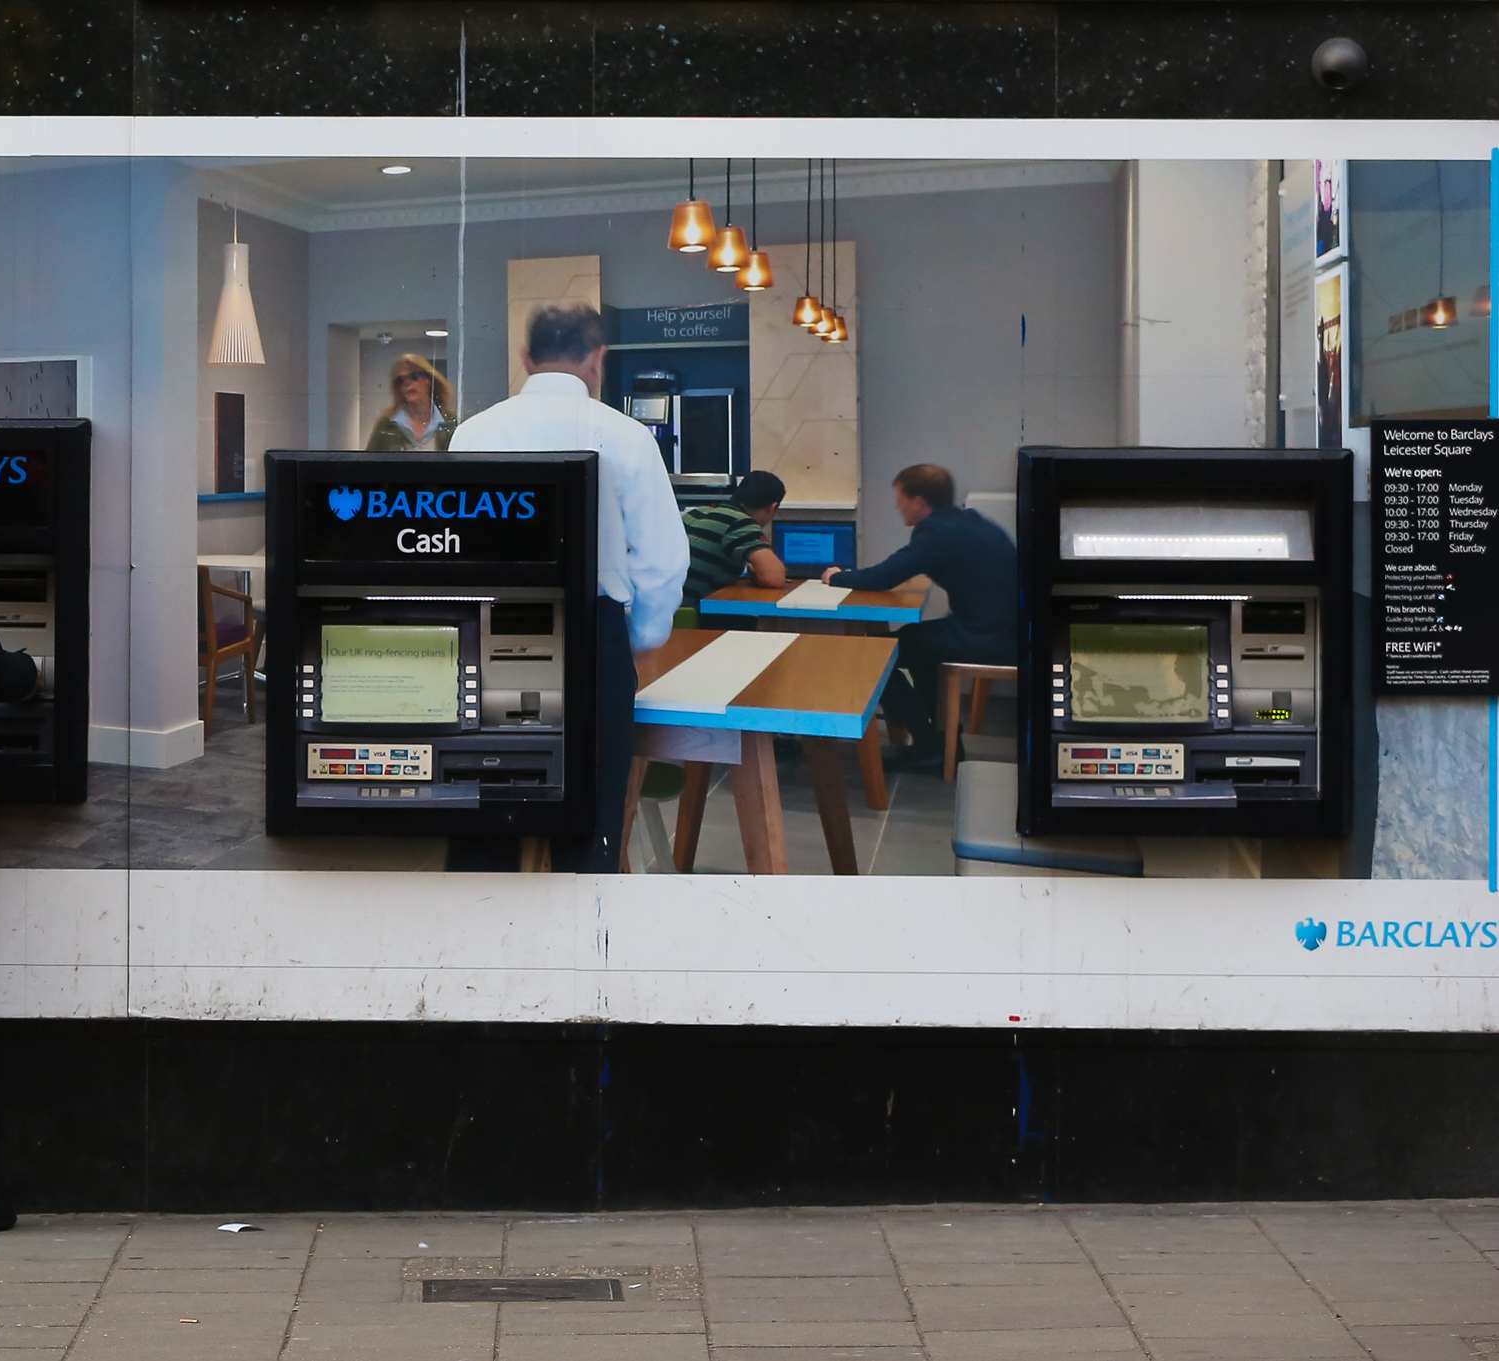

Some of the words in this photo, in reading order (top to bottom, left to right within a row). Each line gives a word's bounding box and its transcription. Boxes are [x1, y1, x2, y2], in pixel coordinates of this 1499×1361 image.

[647, 310, 677, 323] Help
[680, 307, 731, 323] yourself
[664, 328, 676, 337] to
[680, 325, 718, 337] coffee
[1384, 430, 1434, 440] Welcome
[1437, 431, 1448, 440] to
[1451, 429, 1494, 442] Barclays
[1384, 445, 1431, 455] Leicester
[1434, 444, 1471, 457] Square
[1384, 468, 1412, 477] We're
[1414, 470, 1441, 479] open:
[1384, 484, 1409, 492] 09:30
[1417, 484, 1439, 492] 17:00
[1449, 483, 1483, 493] Monday
[367, 491, 535, 518] BARCLAYS
[1385, 496, 1409, 504] 09:30
[1417, 496, 1439, 504] 17:00
[1449, 495, 1483, 505] Tuesday
[1385, 508, 1407, 517] 10:00
[1417, 508, 1439, 516] 17:00
[1449, 507, 1497, 517] Wednesday
[1385, 520, 1409, 529] 09:30
[1417, 520, 1439, 528] 17:00
[1450, 520, 1488, 529] Thursday
[397, 528, 460, 553] Cash
[1385, 532, 1409, 541] 09:30
[1418, 532, 1439, 540] 17:00
[1449, 532, 1474, 542] Friday
[1385, 544, 1413, 553] Closed
[1450, 544, 1486, 554] Saturday
[1386, 642, 1411, 652] FREE
[330, 648, 347, 657] Our
[350, 648, 363, 657] UK
[365, 648, 419, 659] ring-fencing
[421, 649, 446, 658] plans
[1336, 921, 1498, 948] BARCLAYS
